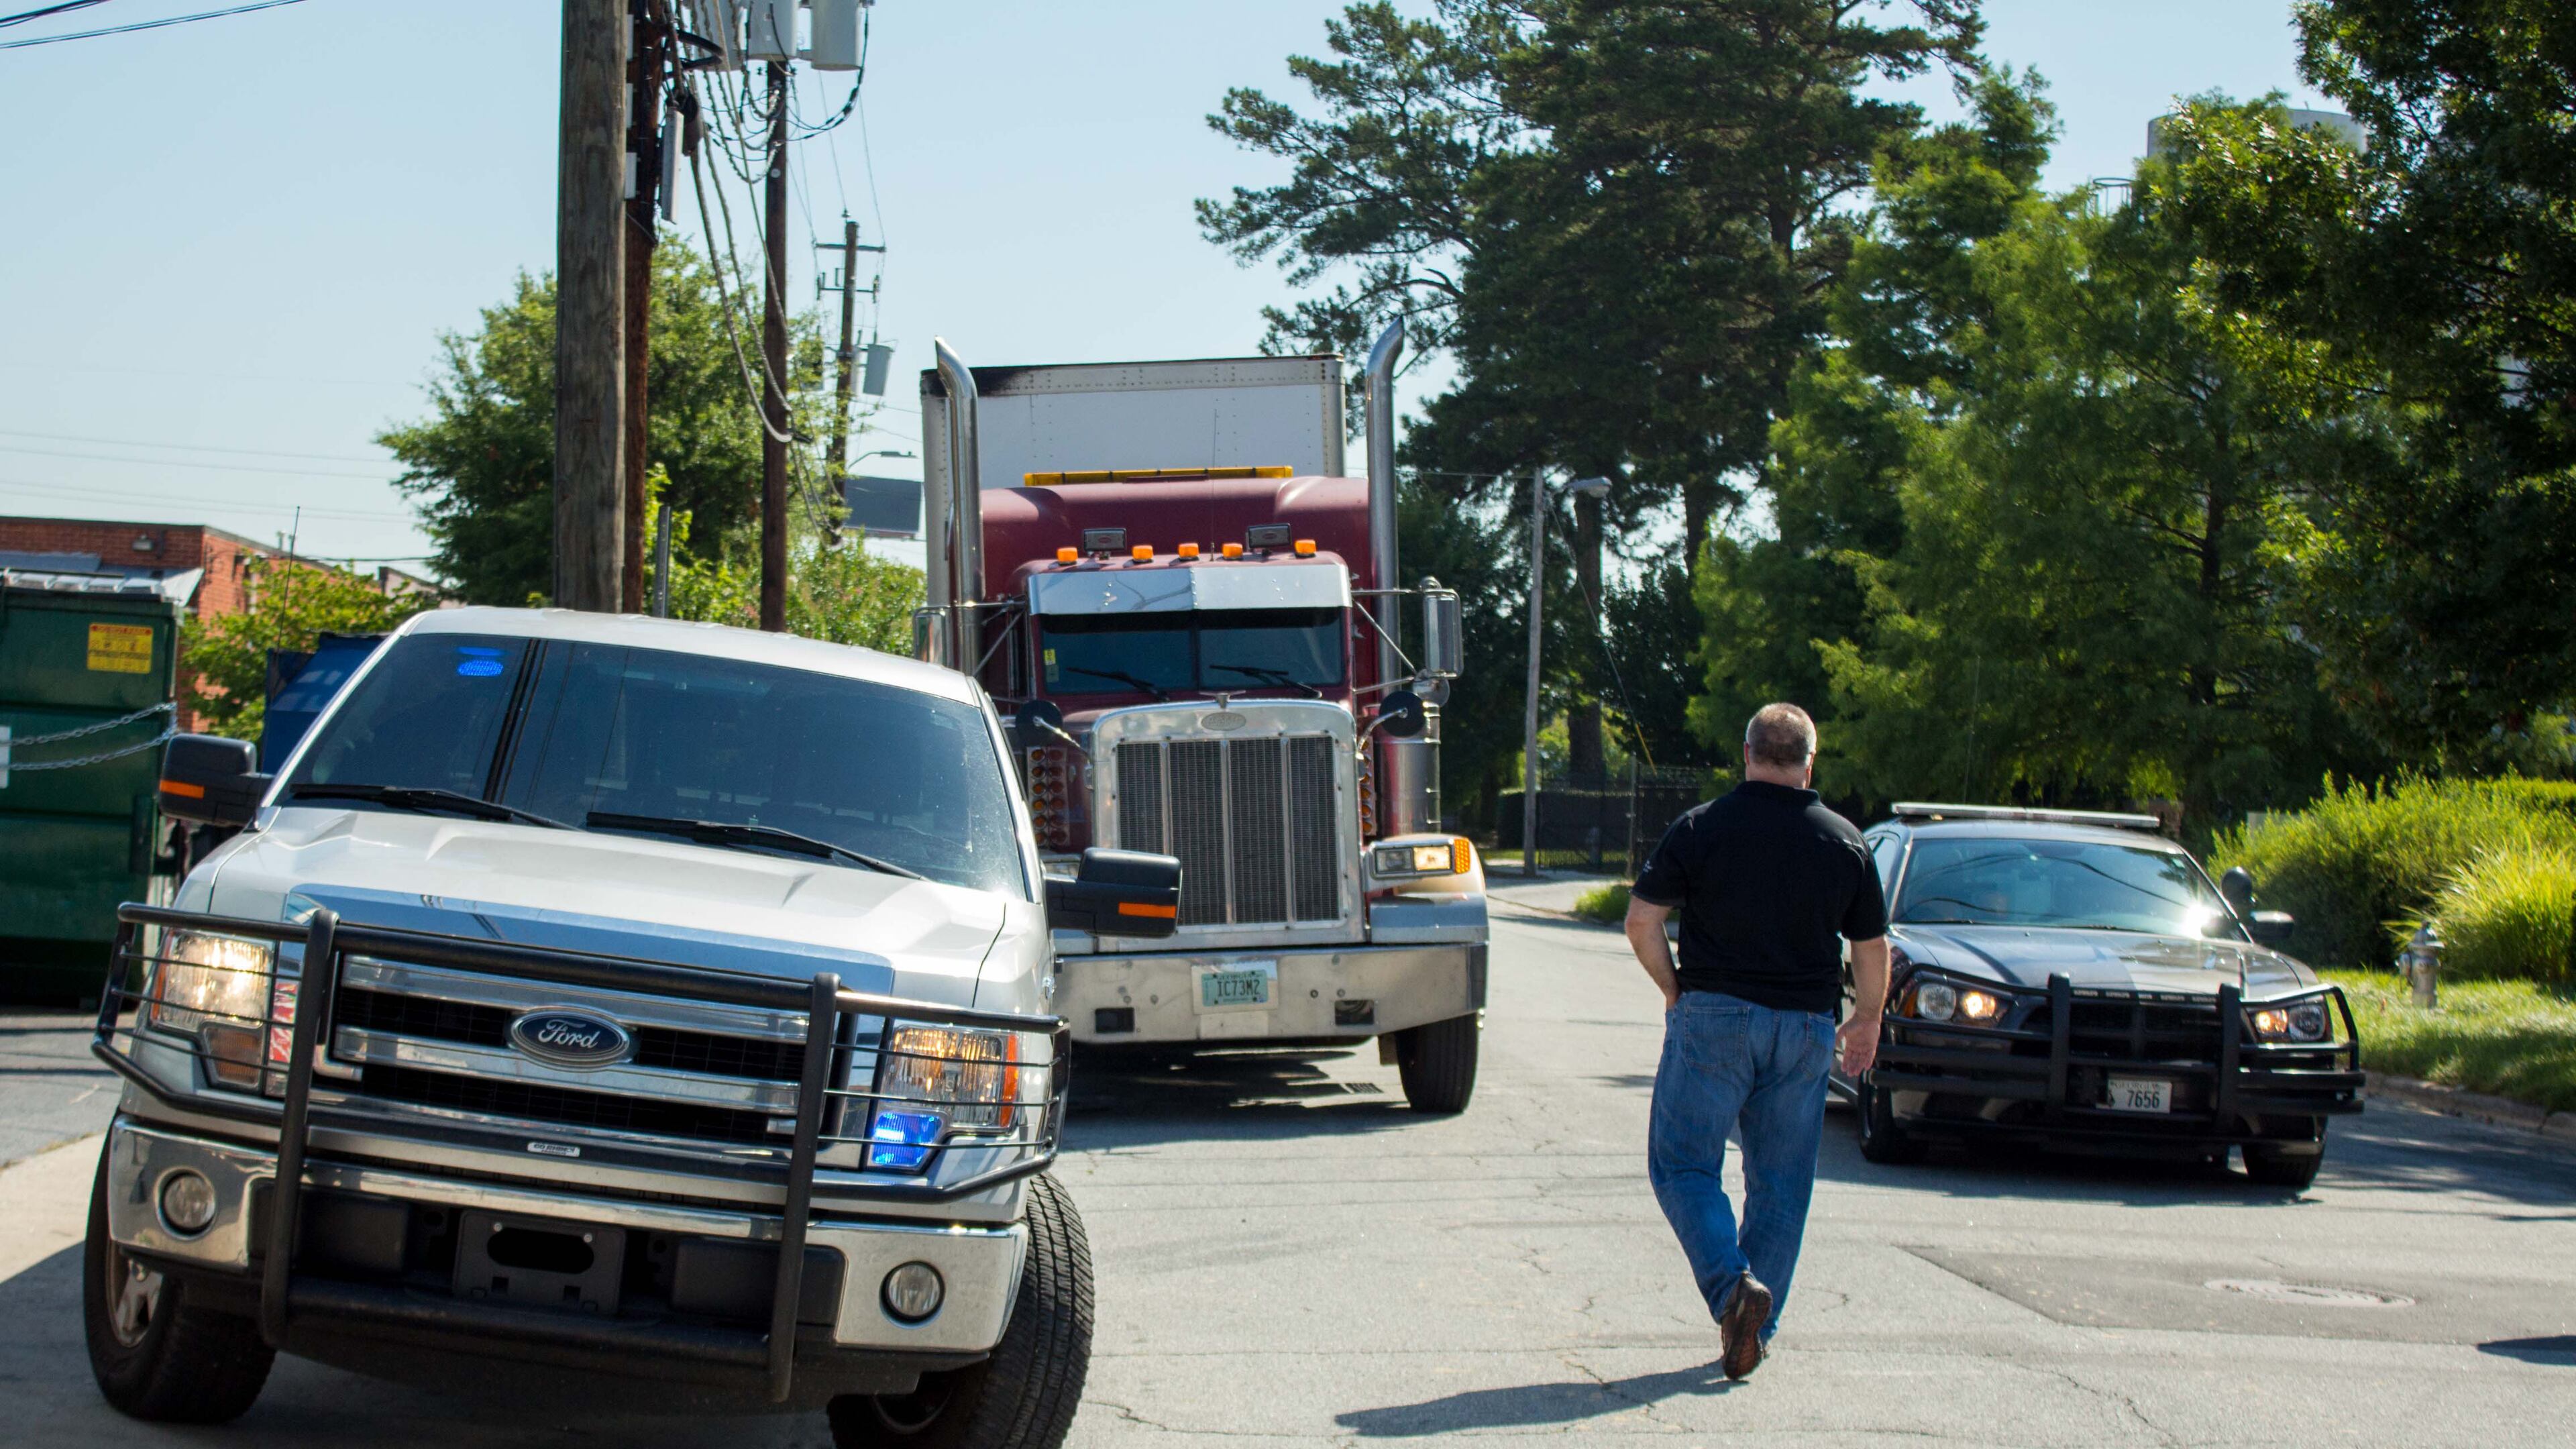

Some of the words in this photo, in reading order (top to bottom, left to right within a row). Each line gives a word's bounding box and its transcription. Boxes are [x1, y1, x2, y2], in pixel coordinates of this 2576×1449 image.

[1217, 979, 1260, 997] IC73M2
[537, 1018, 601, 1049] Ford
[2127, 1089, 2160, 1109] 7656
